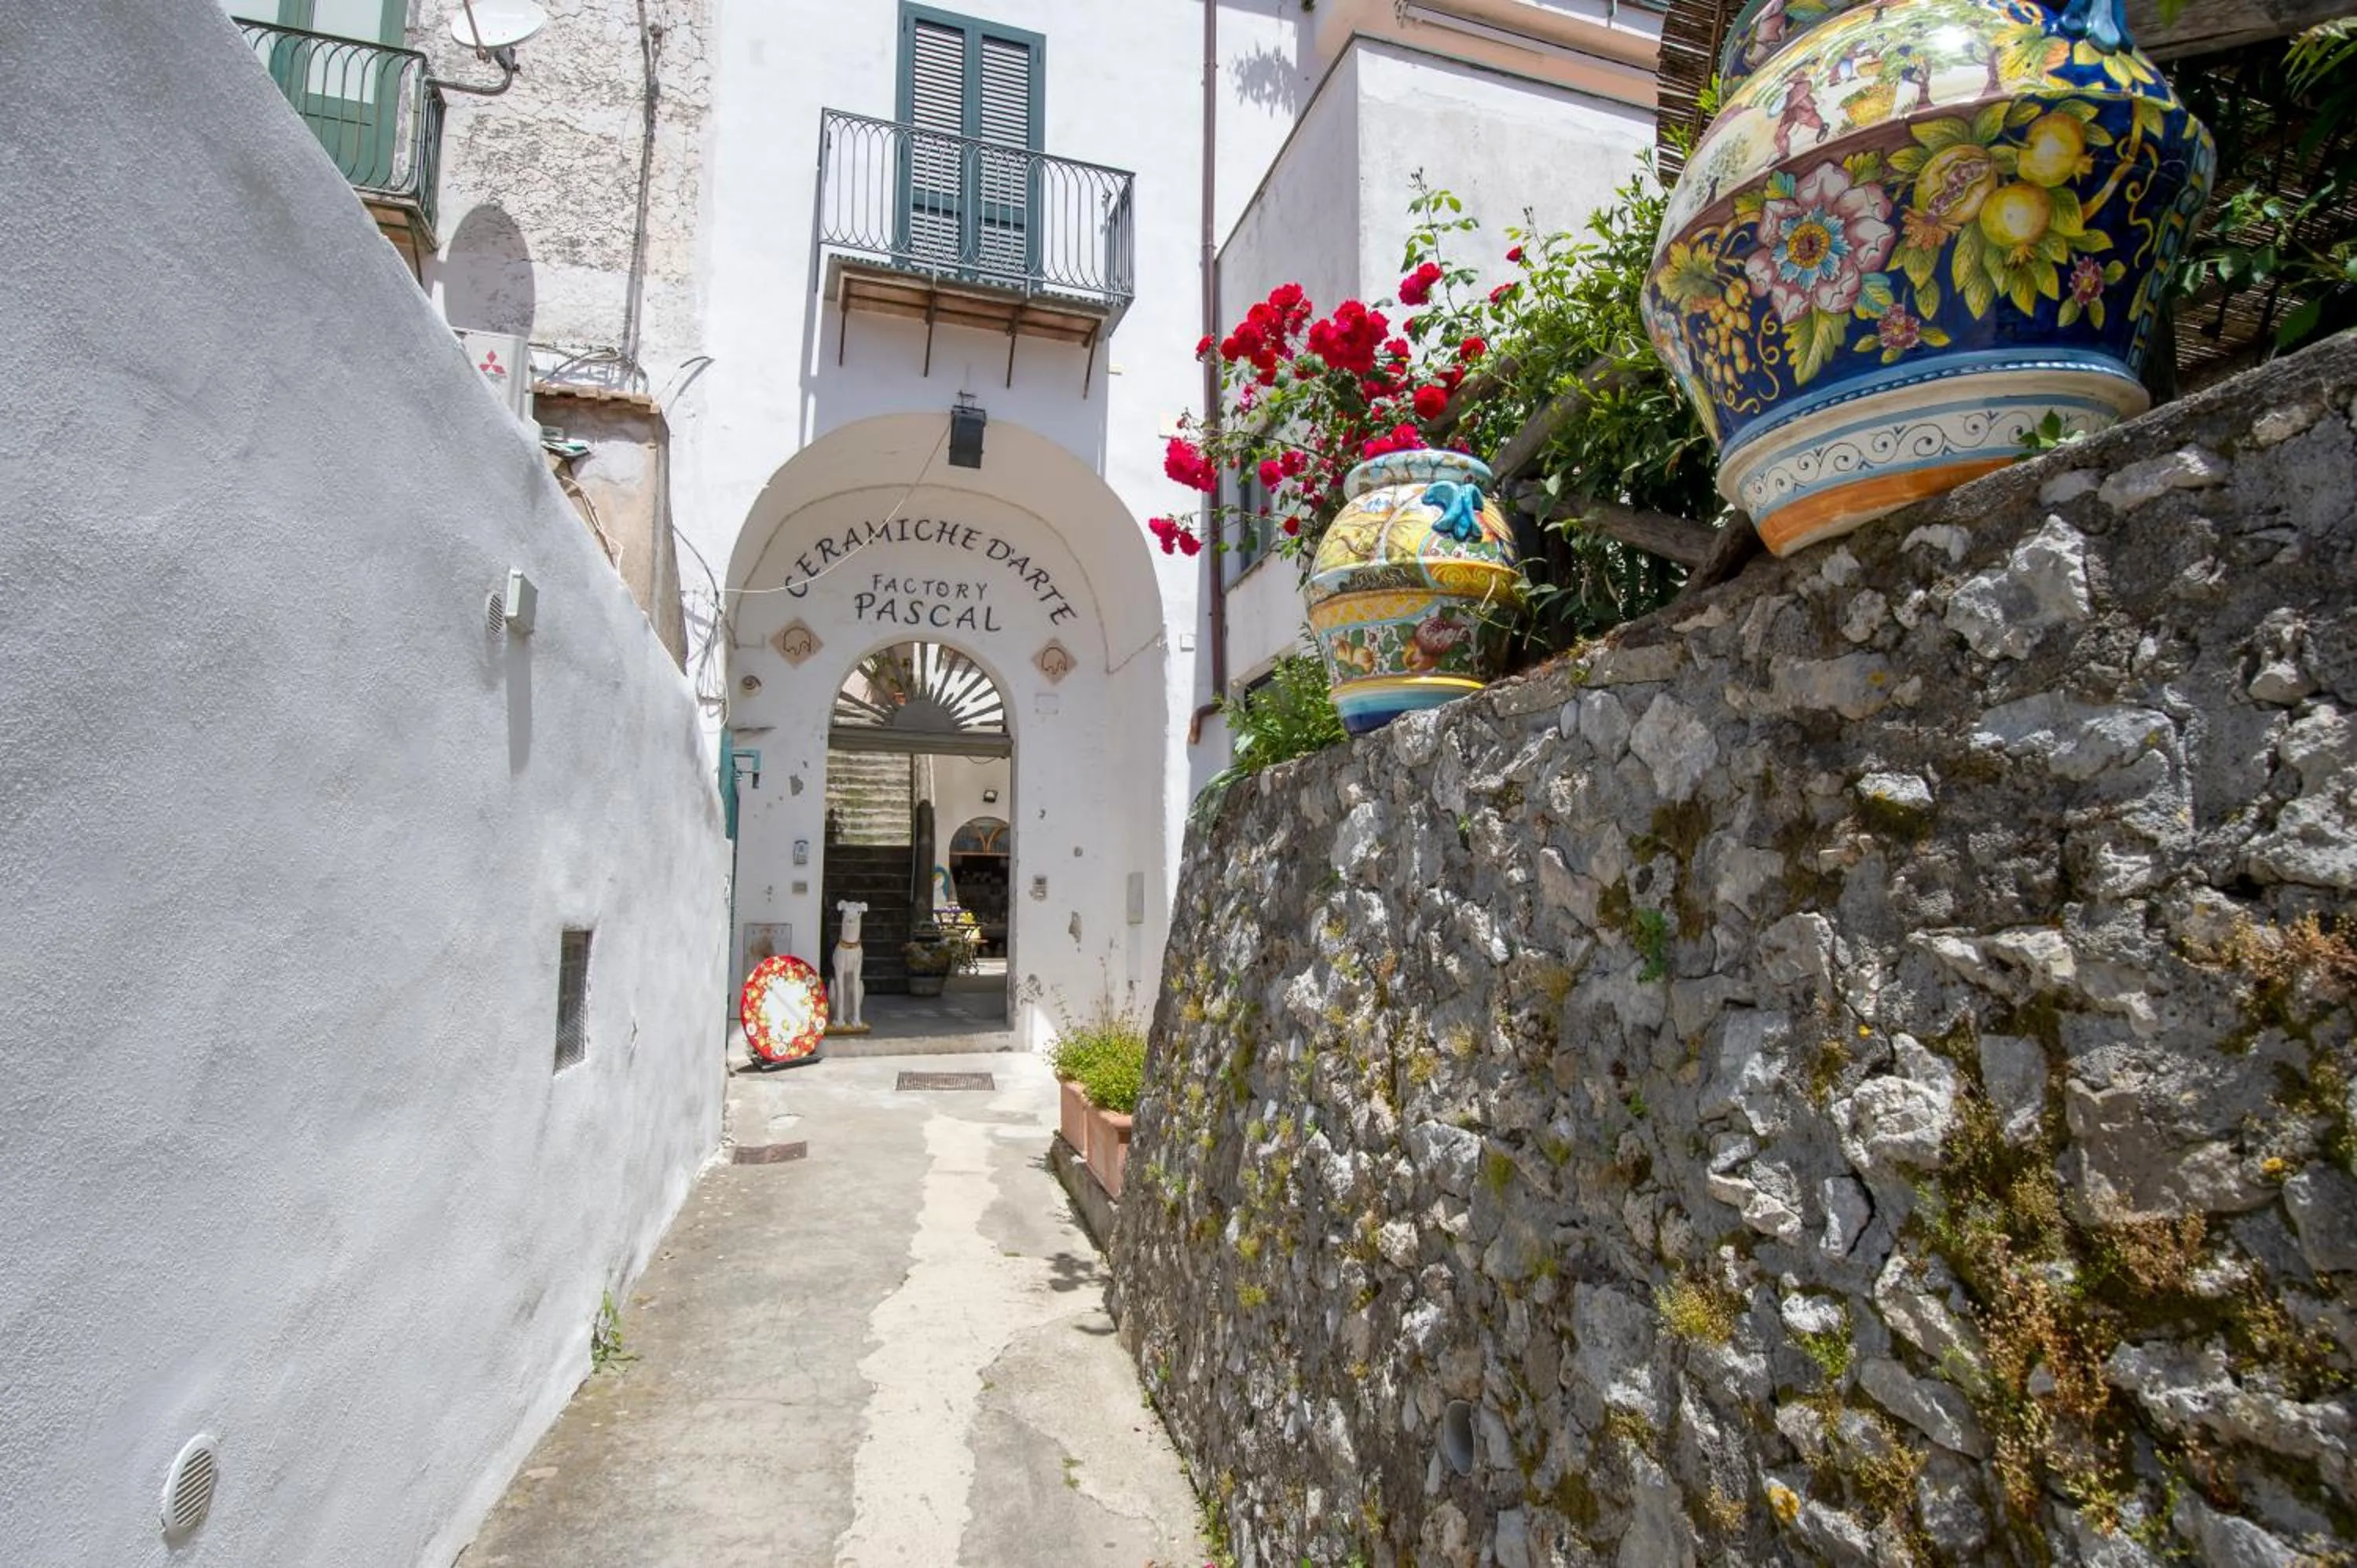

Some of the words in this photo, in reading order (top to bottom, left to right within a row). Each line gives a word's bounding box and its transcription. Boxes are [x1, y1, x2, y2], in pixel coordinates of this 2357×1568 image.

[786, 518, 982, 598] CERAMICHE
[987, 538, 1078, 625] D'ARTE
[872, 573, 988, 602] FACTORY
[854, 592, 1002, 632] PASCAL
